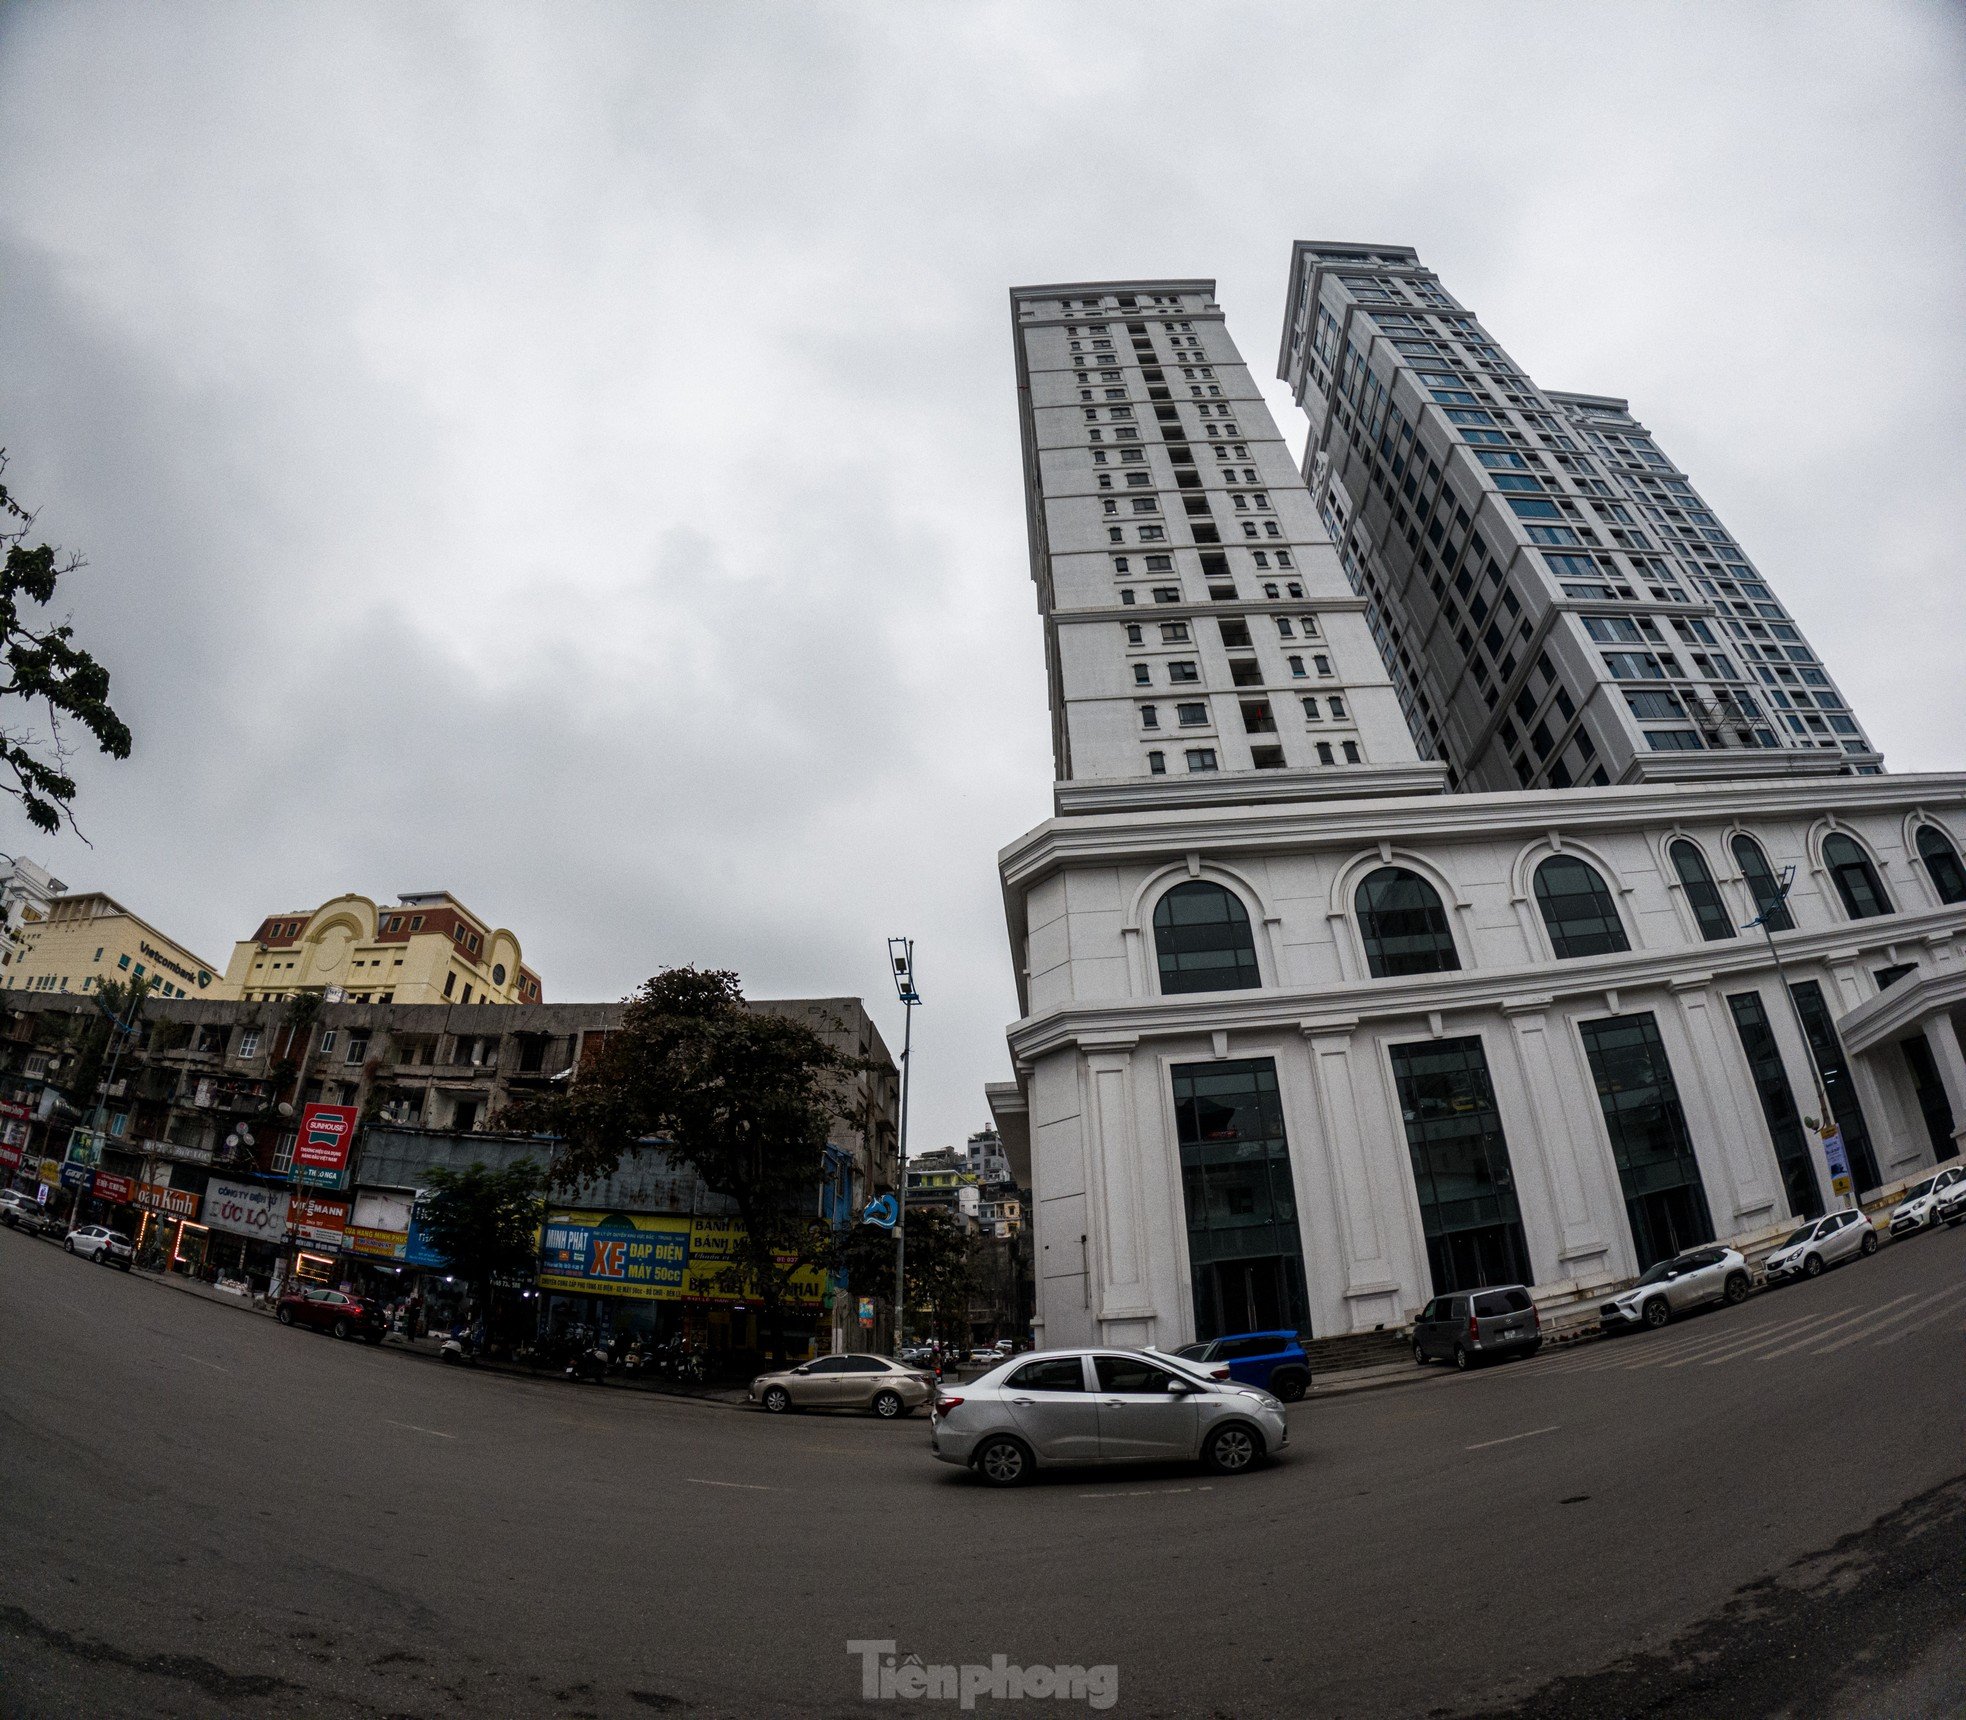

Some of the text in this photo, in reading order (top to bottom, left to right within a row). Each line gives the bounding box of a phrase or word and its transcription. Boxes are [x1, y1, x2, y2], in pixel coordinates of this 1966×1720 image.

[140, 940, 196, 984] Vietcombank
[310, 1121, 344, 1132] SUNHOUSE
[308, 1169, 324, 1178] THO
[324, 1171, 337, 1180] NGA
[161, 1189, 193, 1215] Kính
[218, 1186, 238, 1198] CÔNG
[239, 1191, 249, 1200] TY
[249, 1192, 266, 1205] ĐIỆN
[246, 1207, 278, 1230] LỘC
[374, 1231, 391, 1240] MINH
[546, 1227, 588, 1251] MINH PHÁT
[695, 1234, 728, 1248] BÁNH
[590, 1240, 627, 1277] XE
[629, 1242, 684, 1263] ĐẠP ĐIỆN
[628, 1263, 681, 1282] MÁY 50cc
